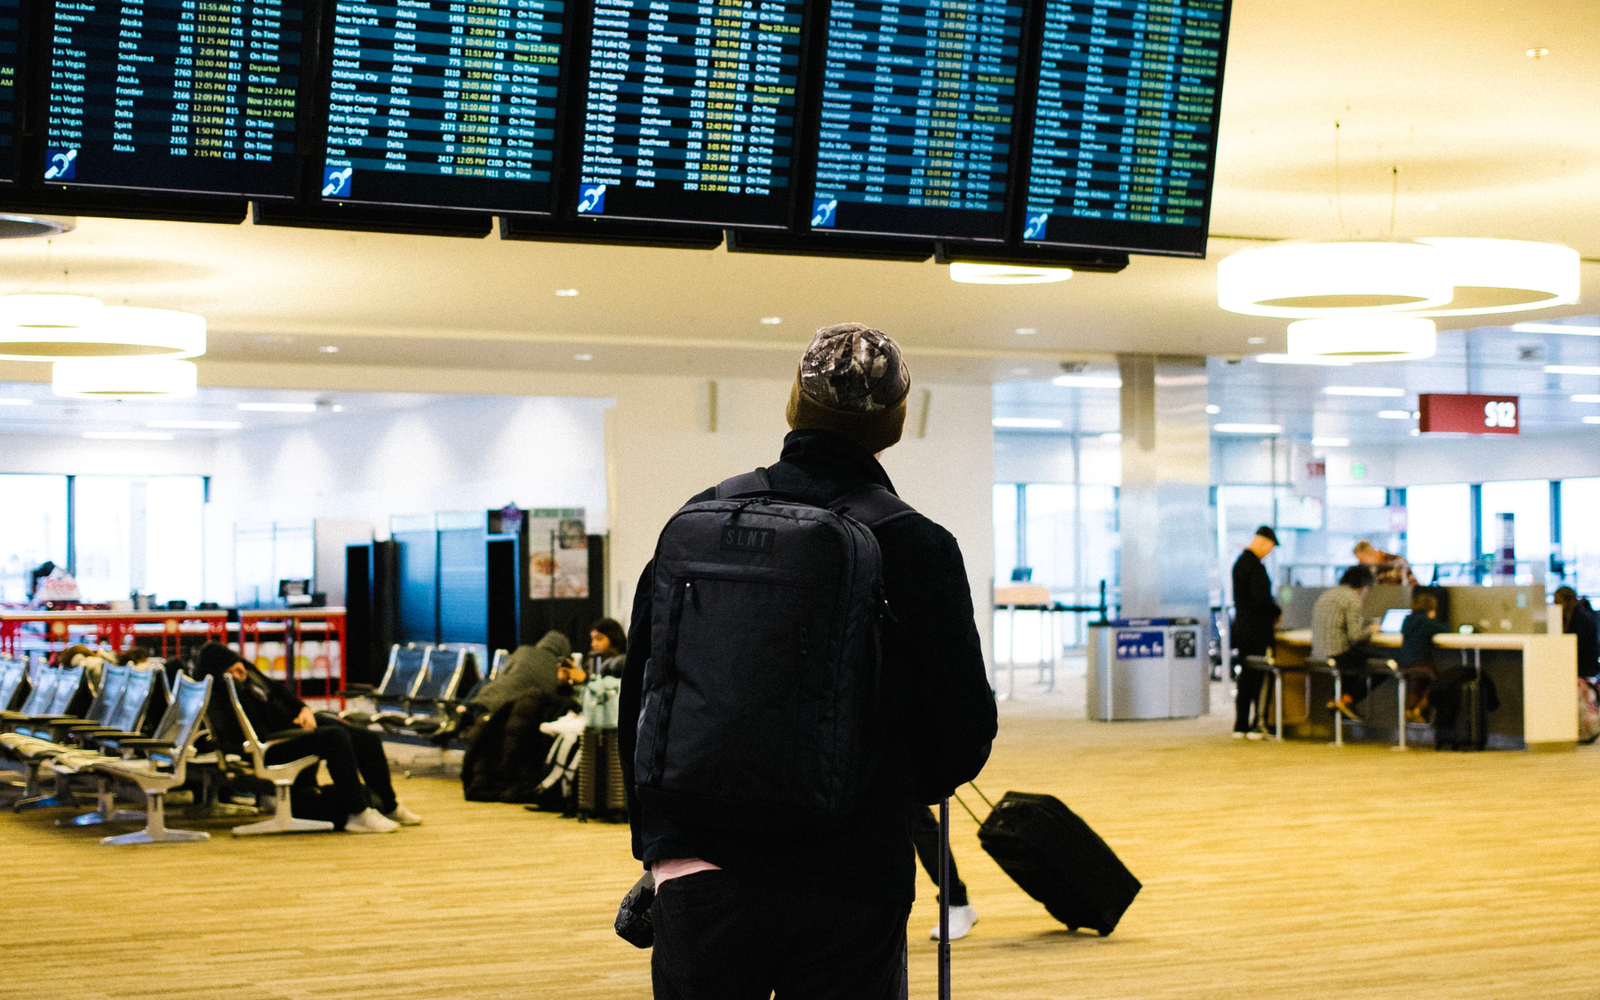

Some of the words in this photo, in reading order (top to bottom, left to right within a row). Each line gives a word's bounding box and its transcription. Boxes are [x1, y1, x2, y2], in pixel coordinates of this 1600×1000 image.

[252, 7, 281, 17] On-Time
[337, 4, 352, 13] New
[121, 7, 143, 16] Alaska
[252, 19, 280, 28] On-Time
[336, 15, 351, 23] New
[55, 13, 85, 22] Kelowna
[120, 18, 143, 27] Alaska
[251, 30, 280, 39] On-Time
[54, 24, 72, 32] Kona
[119, 30, 142, 38] Alaska
[250, 41, 279, 50] On-Time
[335, 26, 360, 35] Newark
[394, 31, 416, 41] Alaska
[515, 32, 542, 41] On-Time
[54, 36, 71, 44] Kona
[119, 41, 137, 50] Delta
[200, 48, 215, 56] 2:05
[250, 52, 278, 62] On-Time
[394, 43, 416, 51] United
[66, 49, 86, 57] Vegas
[118, 53, 154, 62] Southwest
[175, 57, 192, 65] 2720
[196, 59, 214, 67] 10:00
[249, 64, 280, 72] Departed
[393, 53, 427, 64] Southwest
[1, 67, 14, 75] AM
[52, 59, 64, 67] Las
[65, 60, 86, 69] Vegas
[117, 64, 136, 73] Delta
[195, 70, 213, 78] 10:49
[248, 74, 277, 84] On-Time
[365, 72, 378, 82] City
[0, 79, 13, 87] AM
[64, 72, 85, 81] Vegas
[117, 76, 139, 84] Alaska
[51, 82, 63, 90] Las
[64, 83, 85, 92] Vegas
[116, 87, 144, 96] Frontier
[247, 97, 263, 105] Now
[331, 81, 356, 90] Ontario
[391, 86, 408, 94] Delta
[63, 95, 84, 103] Vegas
[116, 98, 133, 107] Spirit
[176, 103, 189, 111] 422
[247, 108, 262, 116] Now
[330, 92, 355, 102] Orange
[354, 94, 378, 104] County
[389, 96, 411, 106] Alaska
[50, 105, 62, 113] Las
[62, 106, 83, 115] Vegas
[115, 109, 133, 118] Delta
[171, 114, 189, 122] 2748
[193, 115, 211, 123] 12:14
[245, 119, 274, 128] On-Time
[509, 117, 535, 127] On-Time
[62, 118, 82, 126] Vegas
[114, 121, 132, 130] Spirit
[245, 130, 273, 139] On-Time
[329, 114, 346, 122] Palm
[345, 115, 370, 126] Springs
[388, 118, 406, 127] Delta
[440, 122, 456, 131] 2171
[507, 127, 535, 137] On-Time
[871, 125, 885, 133] Delta
[49, 128, 60, 136] Las
[61, 129, 82, 138] Vegas
[113, 132, 132, 141] Delta
[170, 136, 187, 145] 2155
[244, 141, 273, 151] On-Time
[327, 136, 343, 145] Paris
[507, 139, 533, 148] On-Time
[61, 141, 81, 149] Vegas
[113, 144, 135, 152] Alaska
[638, 148, 654, 156] Delta
[327, 147, 345, 155] Pasco
[386, 152, 406, 160] Alaska
[594, 156, 622, 164] Francisco
[326, 158, 352, 167] Phoenix
[385, 162, 406, 171] Alaska
[1484, 401, 1516, 428] S12
[726, 529, 769, 547] SLNT
